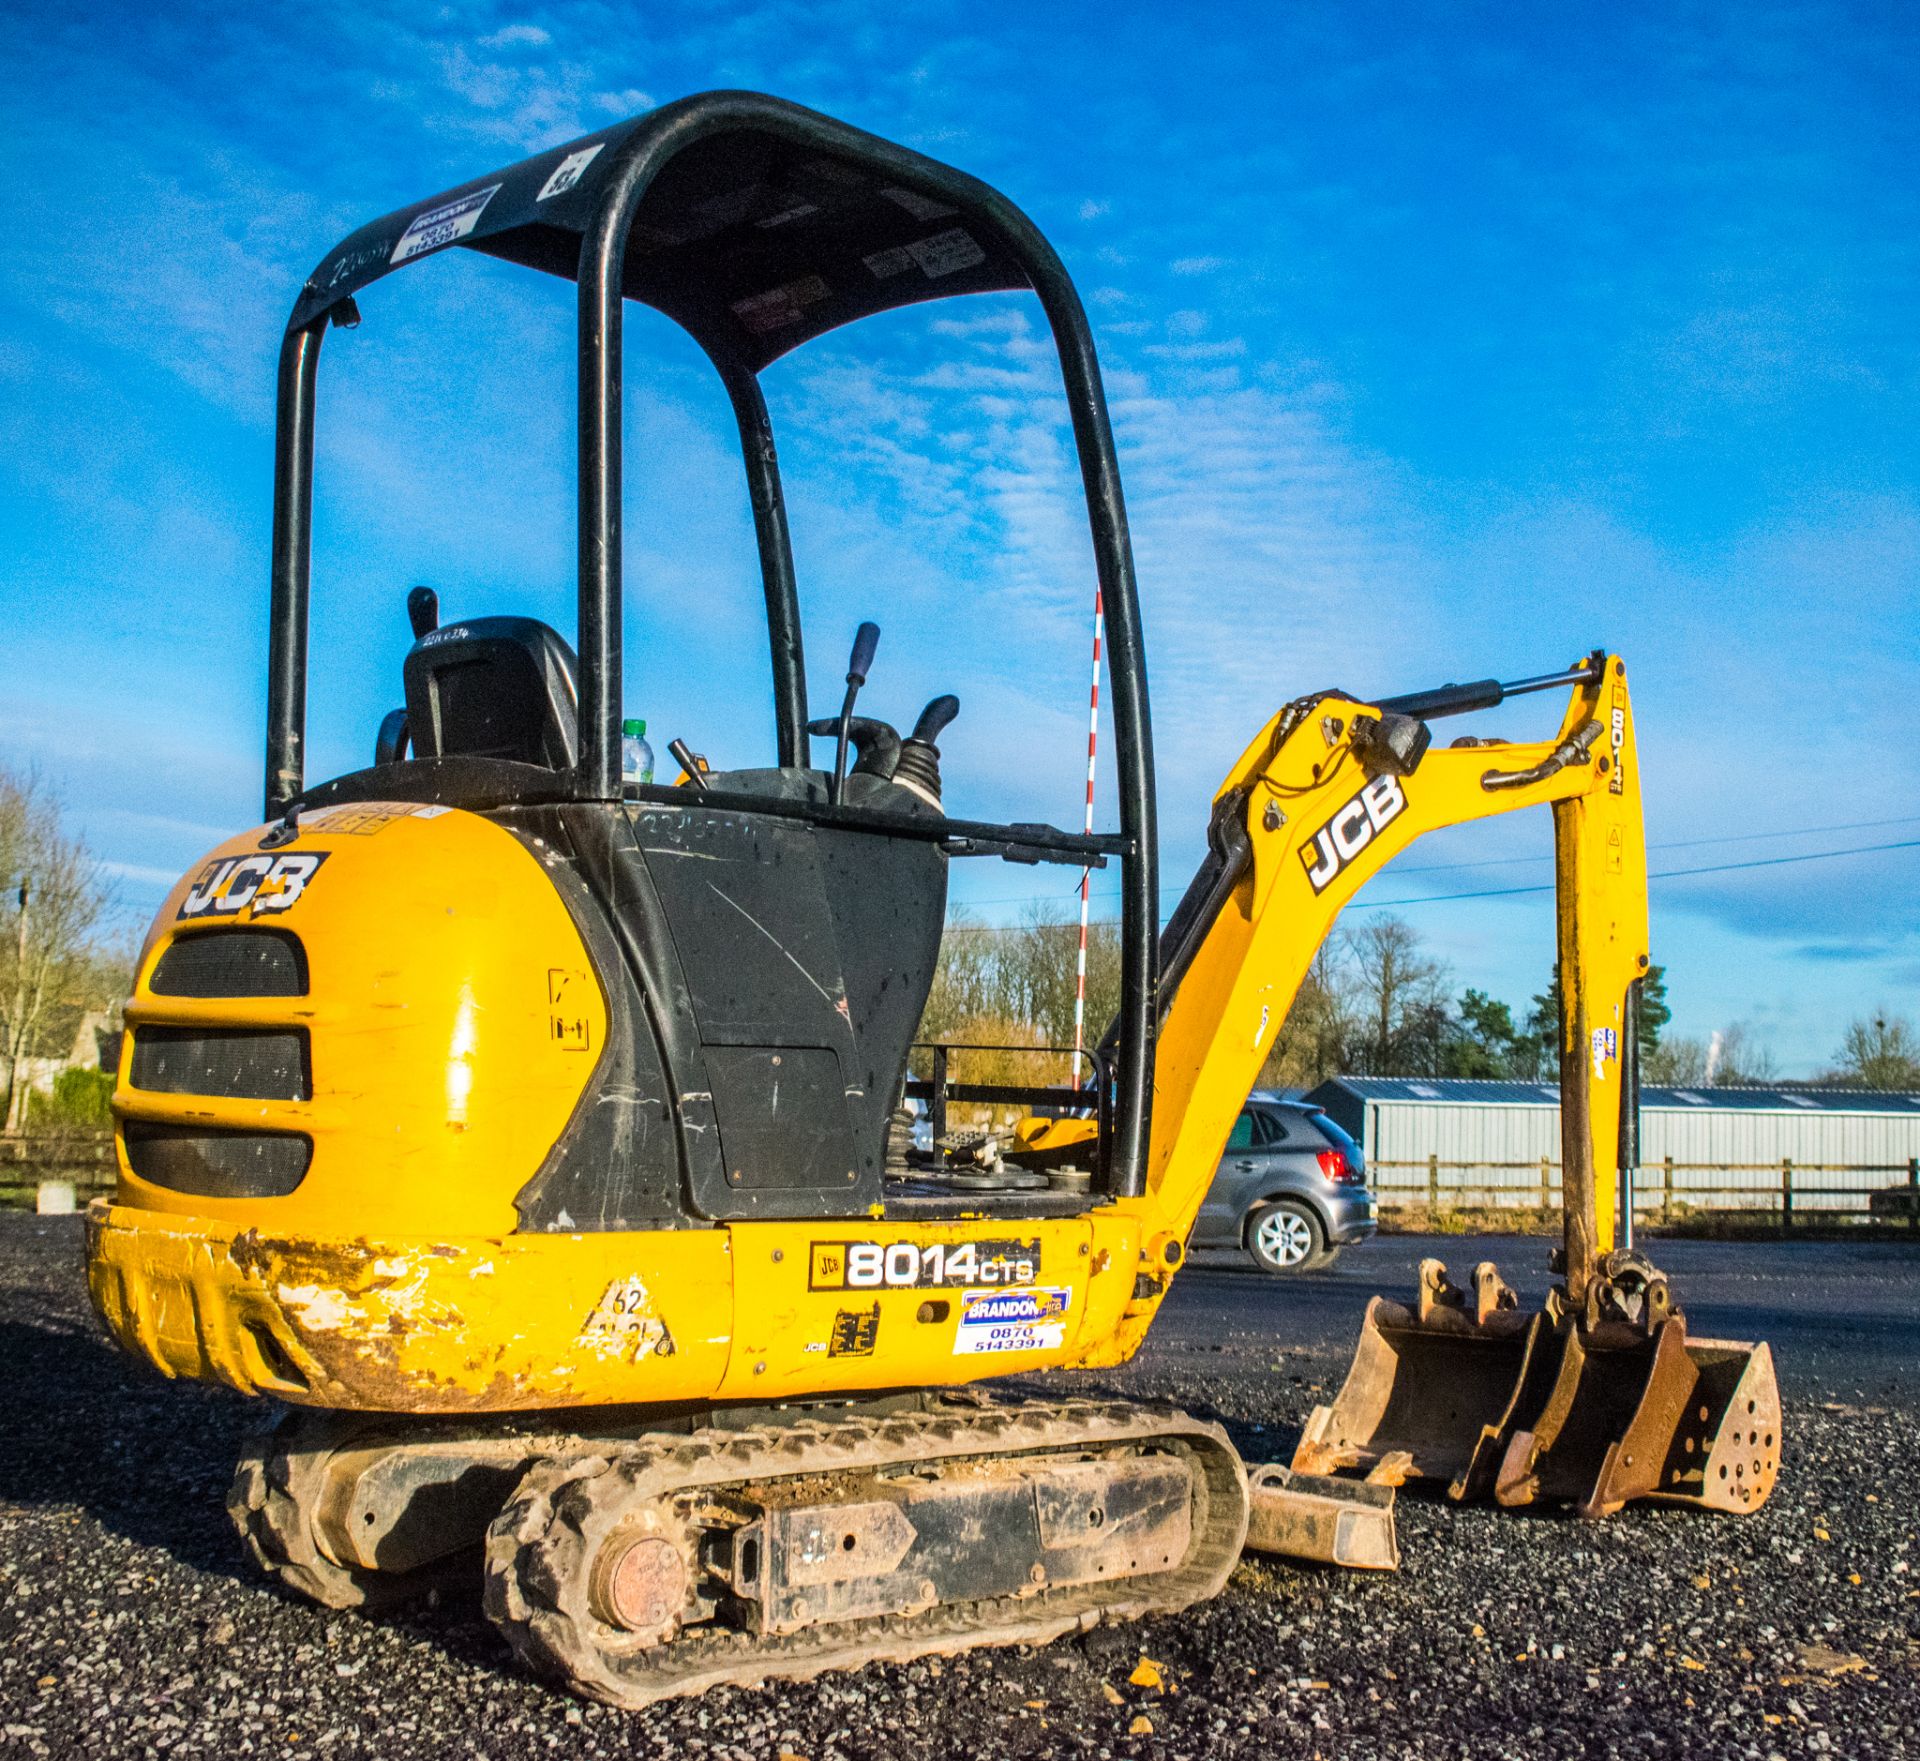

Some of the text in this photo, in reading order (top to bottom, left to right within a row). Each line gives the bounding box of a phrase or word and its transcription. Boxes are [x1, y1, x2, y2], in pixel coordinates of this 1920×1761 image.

[1310, 774, 1404, 888] JCB
[183, 855, 319, 914] JCB
[821, 1243, 1034, 1287] JCB 8014 CTS
[968, 1300, 1040, 1319] BRANDON
[990, 1327, 1034, 1340] 0870
[803, 1343, 827, 1353] JCB
[974, 1338, 1044, 1352] 5143391
